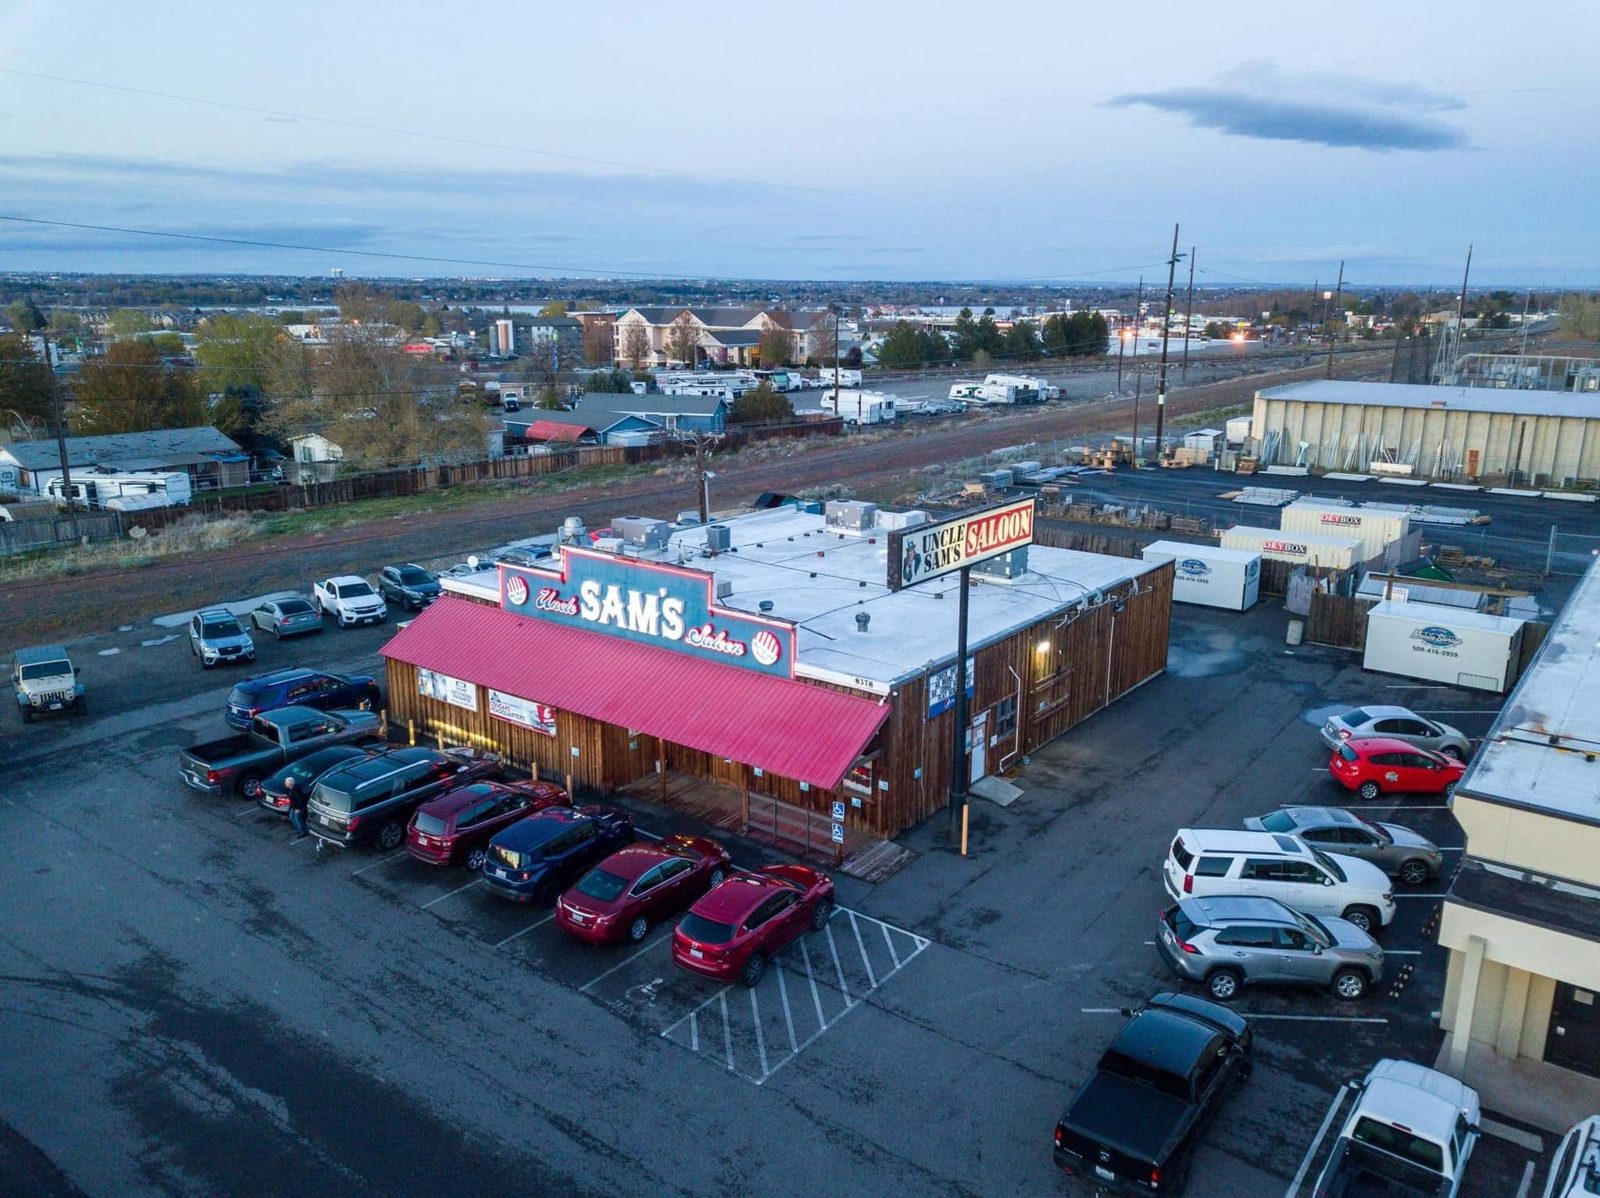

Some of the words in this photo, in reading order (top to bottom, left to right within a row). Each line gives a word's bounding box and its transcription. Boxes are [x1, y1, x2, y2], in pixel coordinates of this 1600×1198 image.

[922, 523, 965, 553] UNCLE
[966, 508, 1032, 554] SALOON
[923, 543, 961, 573] SAM'S
[535, 588, 579, 615] Uncle
[580, 580, 684, 640] SAM'S
[685, 624, 747, 656] Saloon
[1412, 645, 1459, 658] 509-416-5959
[855, 677, 874, 688] 8378
